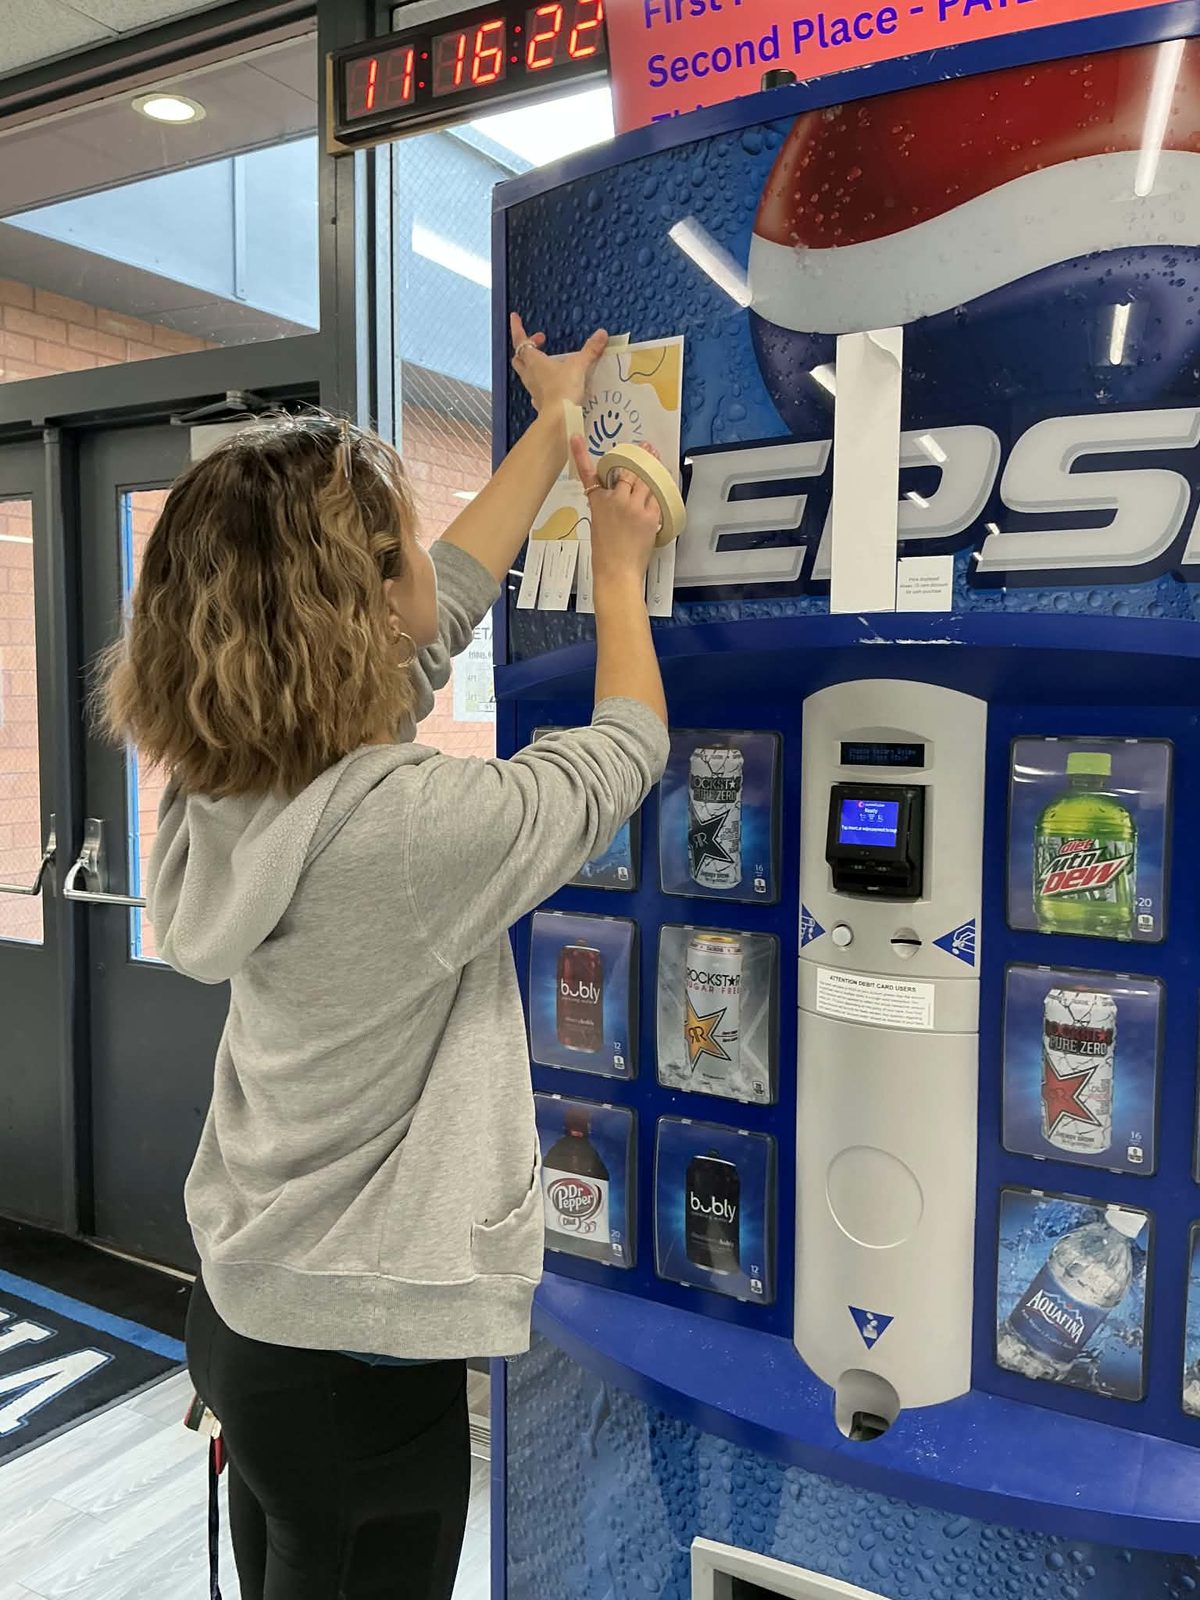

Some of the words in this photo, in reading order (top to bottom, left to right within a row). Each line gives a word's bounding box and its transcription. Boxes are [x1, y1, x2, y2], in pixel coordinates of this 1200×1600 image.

[648, 24, 780, 88] Second
[793, 6, 897, 54] Place
[603, 390, 622, 405] TO
[623, 400, 642, 444] LOV
[672, 406, 1200, 589] EPS
[1138, 897, 1153, 907] 20
[560, 977, 600, 1004] bubly
[688, 981, 714, 994] UGAR
[829, 975, 858, 985] ATTENTION
[894, 985, 917, 993] USERS
[1079, 1040, 1108, 1056] ZERO
[1131, 1131, 1142, 1140] 16
[558, 1185, 593, 1212] Pepper
[568, 1184, 584, 1198] Dr
[690, 1191, 737, 1223] bubly
[1025, 1288, 1085, 1344] AQUAFINA
